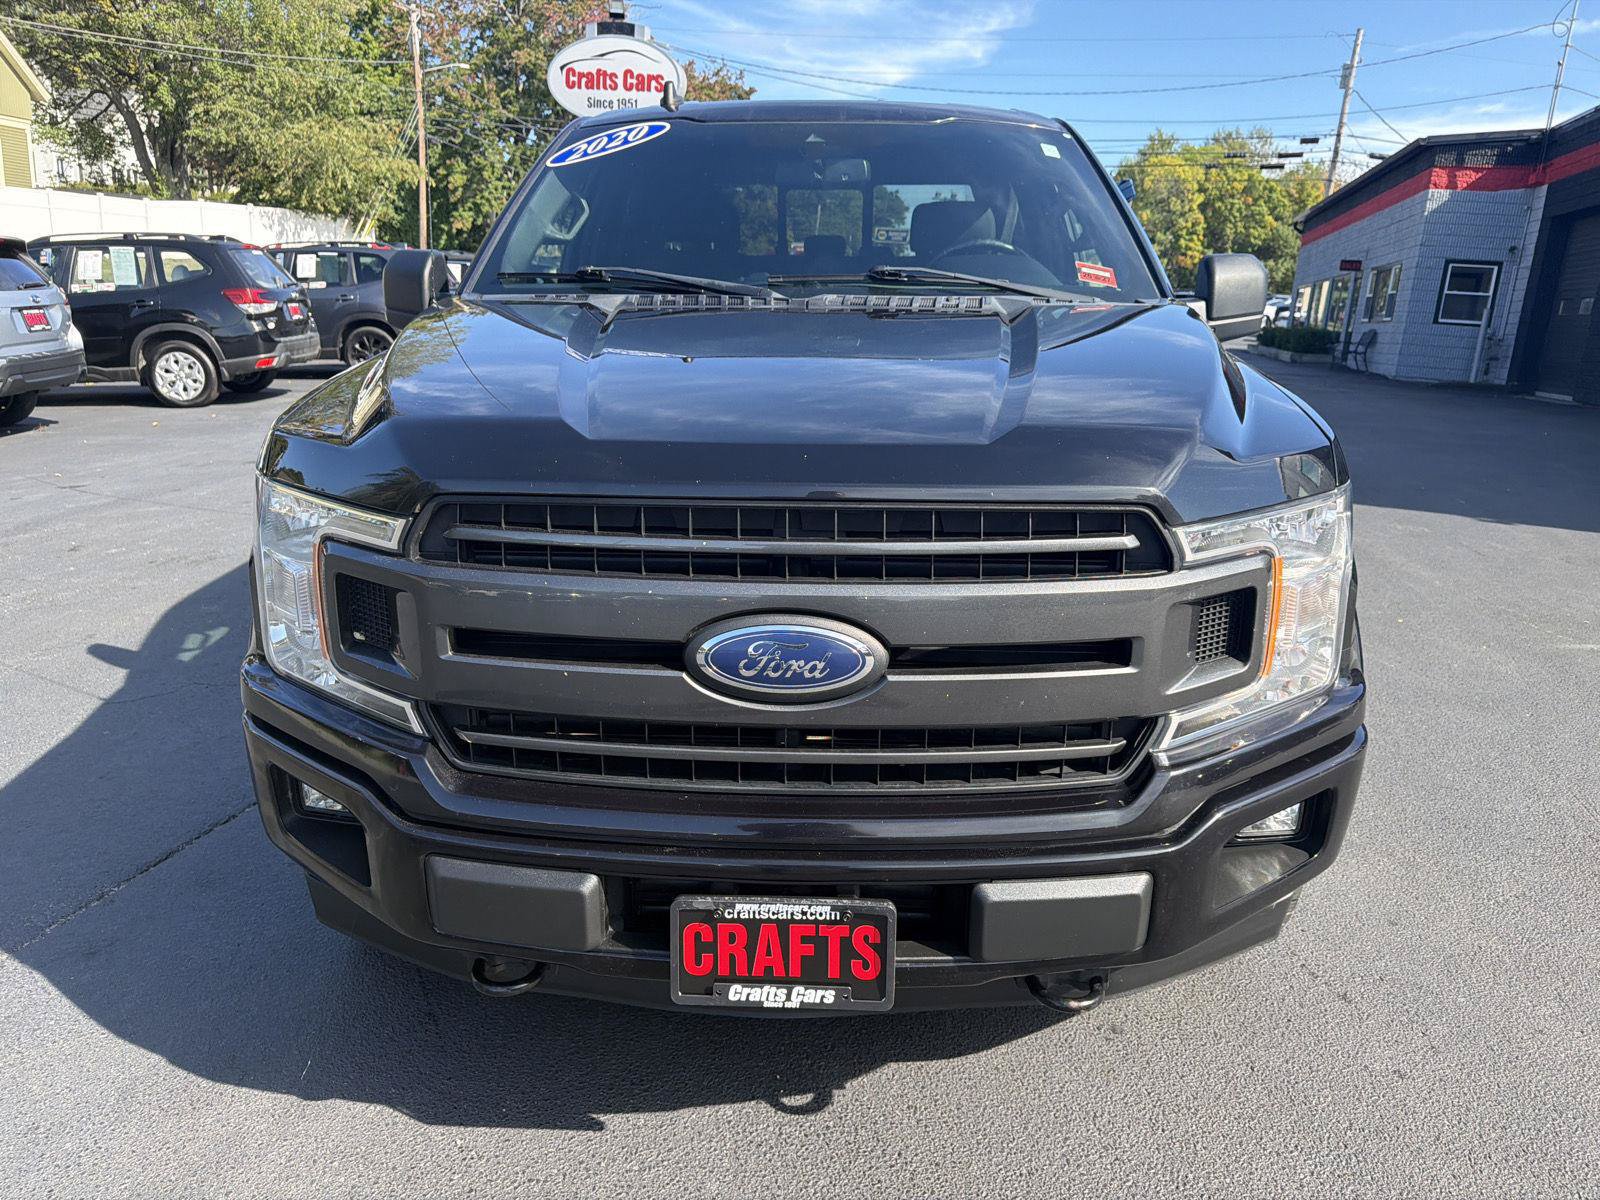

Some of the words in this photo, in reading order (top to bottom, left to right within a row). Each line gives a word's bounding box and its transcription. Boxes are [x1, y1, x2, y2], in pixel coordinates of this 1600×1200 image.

[564, 66, 619, 91] Crafts
[622, 68, 665, 93] Cars
[587, 97, 614, 109] Since
[617, 98, 639, 109] 1951
[565, 125, 650, 162] 2020
[738, 640, 832, 678] Ford
[683, 922, 882, 981] CRAFTS
[728, 984, 787, 1002] Crafts
[790, 986, 836, 1004] Cars
